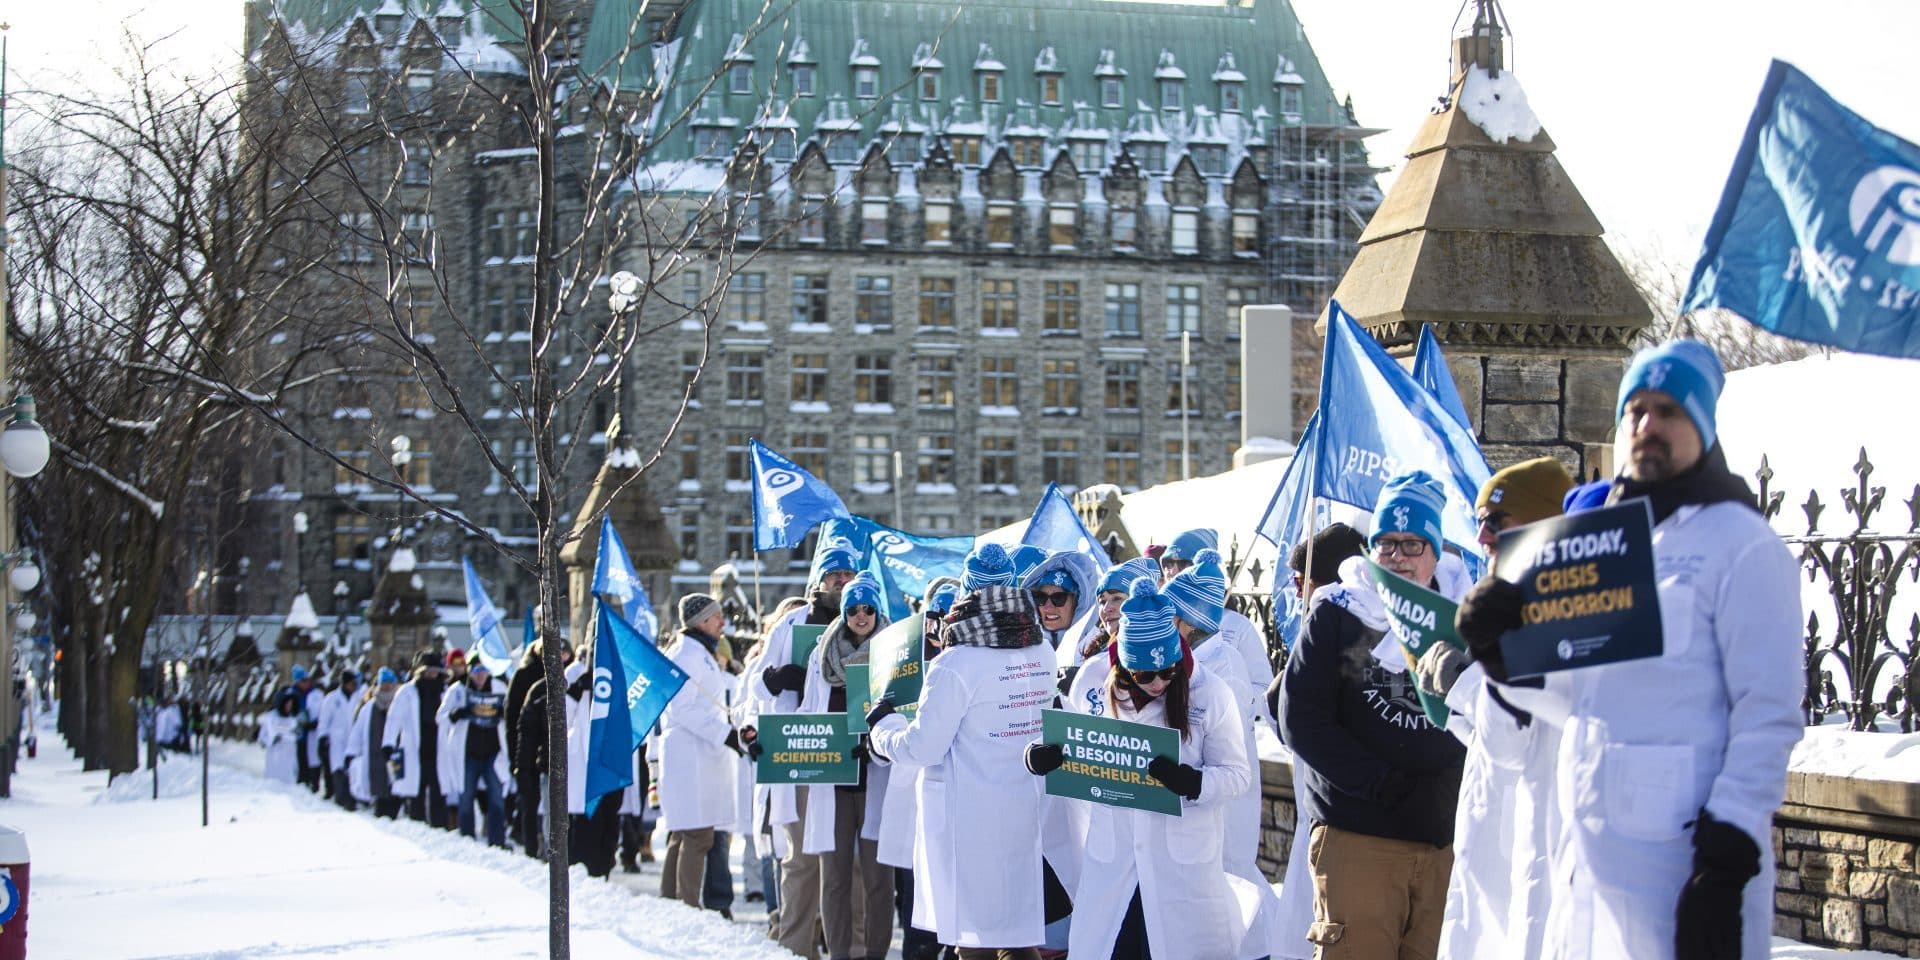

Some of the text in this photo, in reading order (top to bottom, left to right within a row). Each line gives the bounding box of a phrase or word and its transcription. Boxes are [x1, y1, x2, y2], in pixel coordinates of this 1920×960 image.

[1559, 528, 1627, 562] TODAY,
[1536, 563, 1599, 594] CRISIS
[1363, 689, 1436, 730] ATLANT
[782, 724, 834, 735] CANADA
[1067, 726, 1152, 753] LE CANADA
[787, 738, 828, 749] NEEDS
[1062, 743, 1072, 757] A
[1075, 747, 1131, 767] BESOIN
[772, 752, 842, 763] SCIENTISTS
[1059, 760, 1164, 788] HERCHEUR.SE
